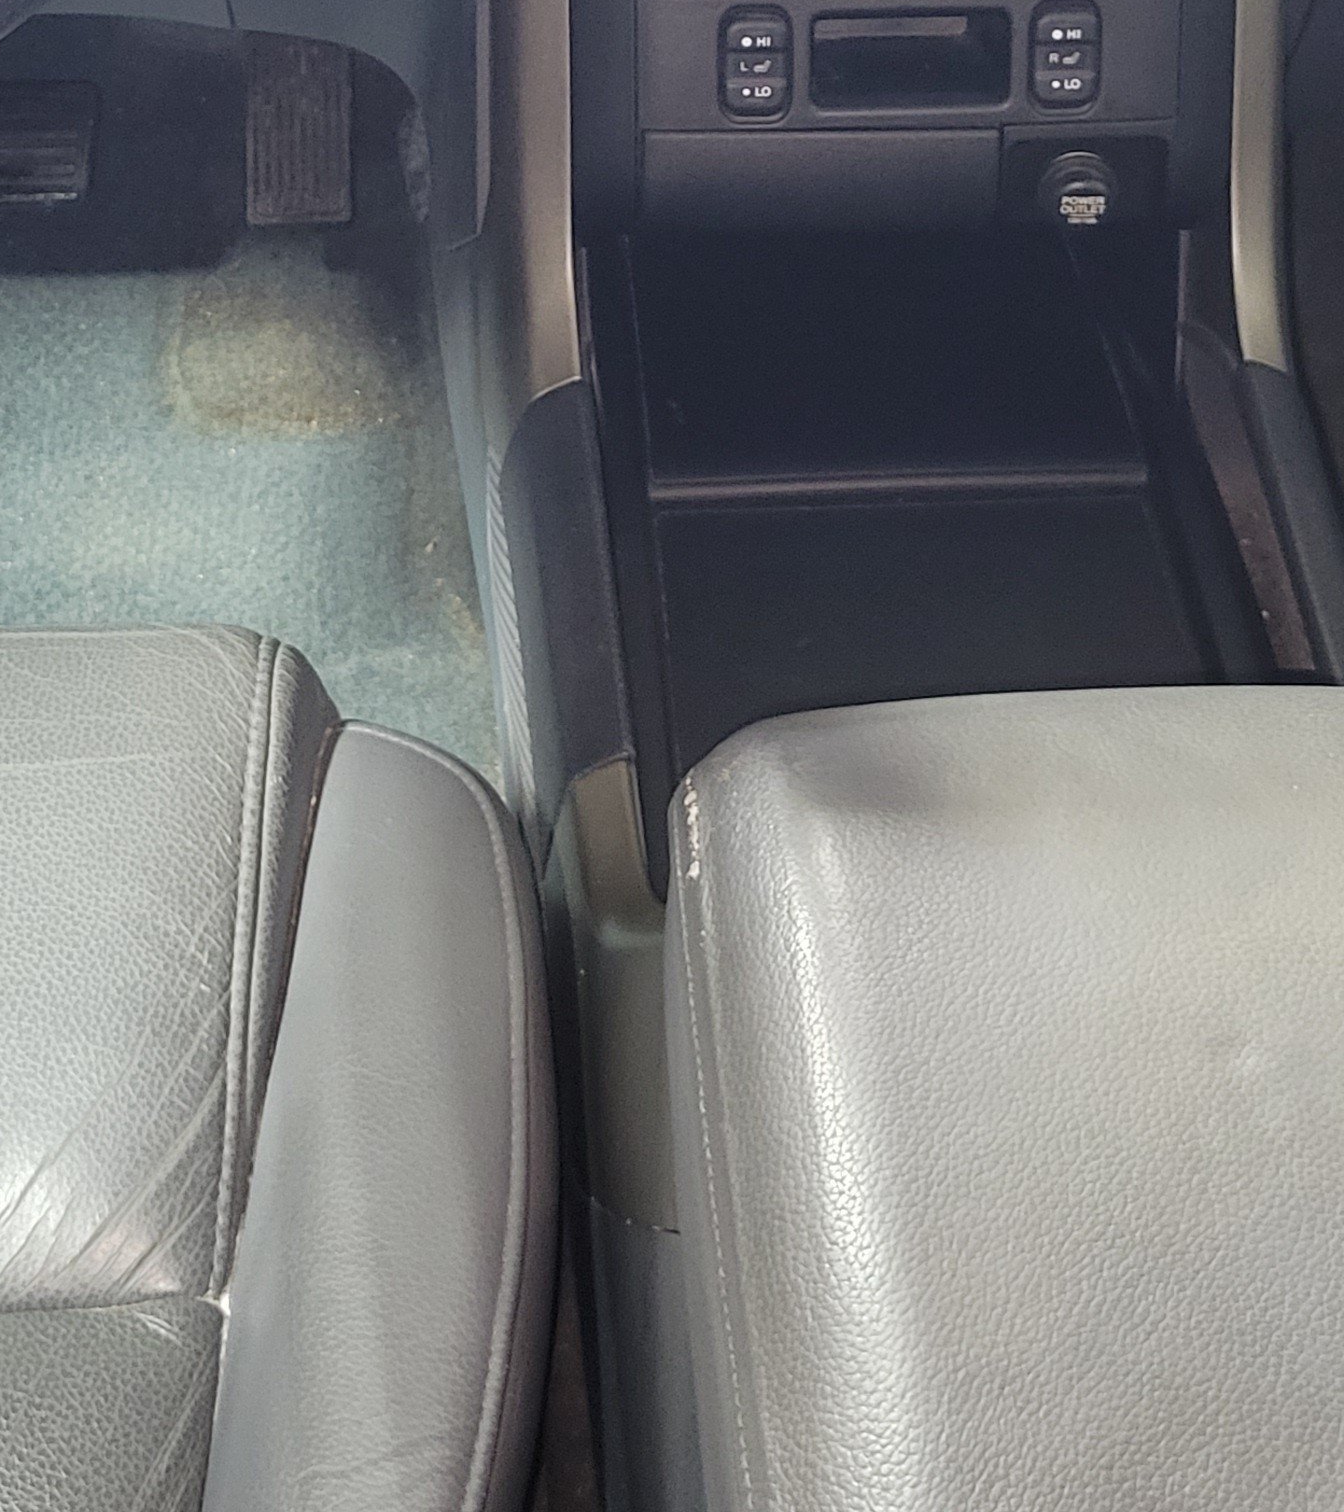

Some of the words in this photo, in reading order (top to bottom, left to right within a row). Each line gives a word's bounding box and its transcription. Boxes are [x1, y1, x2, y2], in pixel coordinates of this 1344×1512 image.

[1066, 28, 1082, 40] HI
[757, 36, 772, 48] HI
[1049, 52, 1059, 64] R
[740, 61, 749, 72] L
[1064, 78, 1082, 90] LO
[755, 86, 773, 98] LO
[1061, 196, 1106, 205] POWER
[1059, 204, 1106, 215] OUTLET
